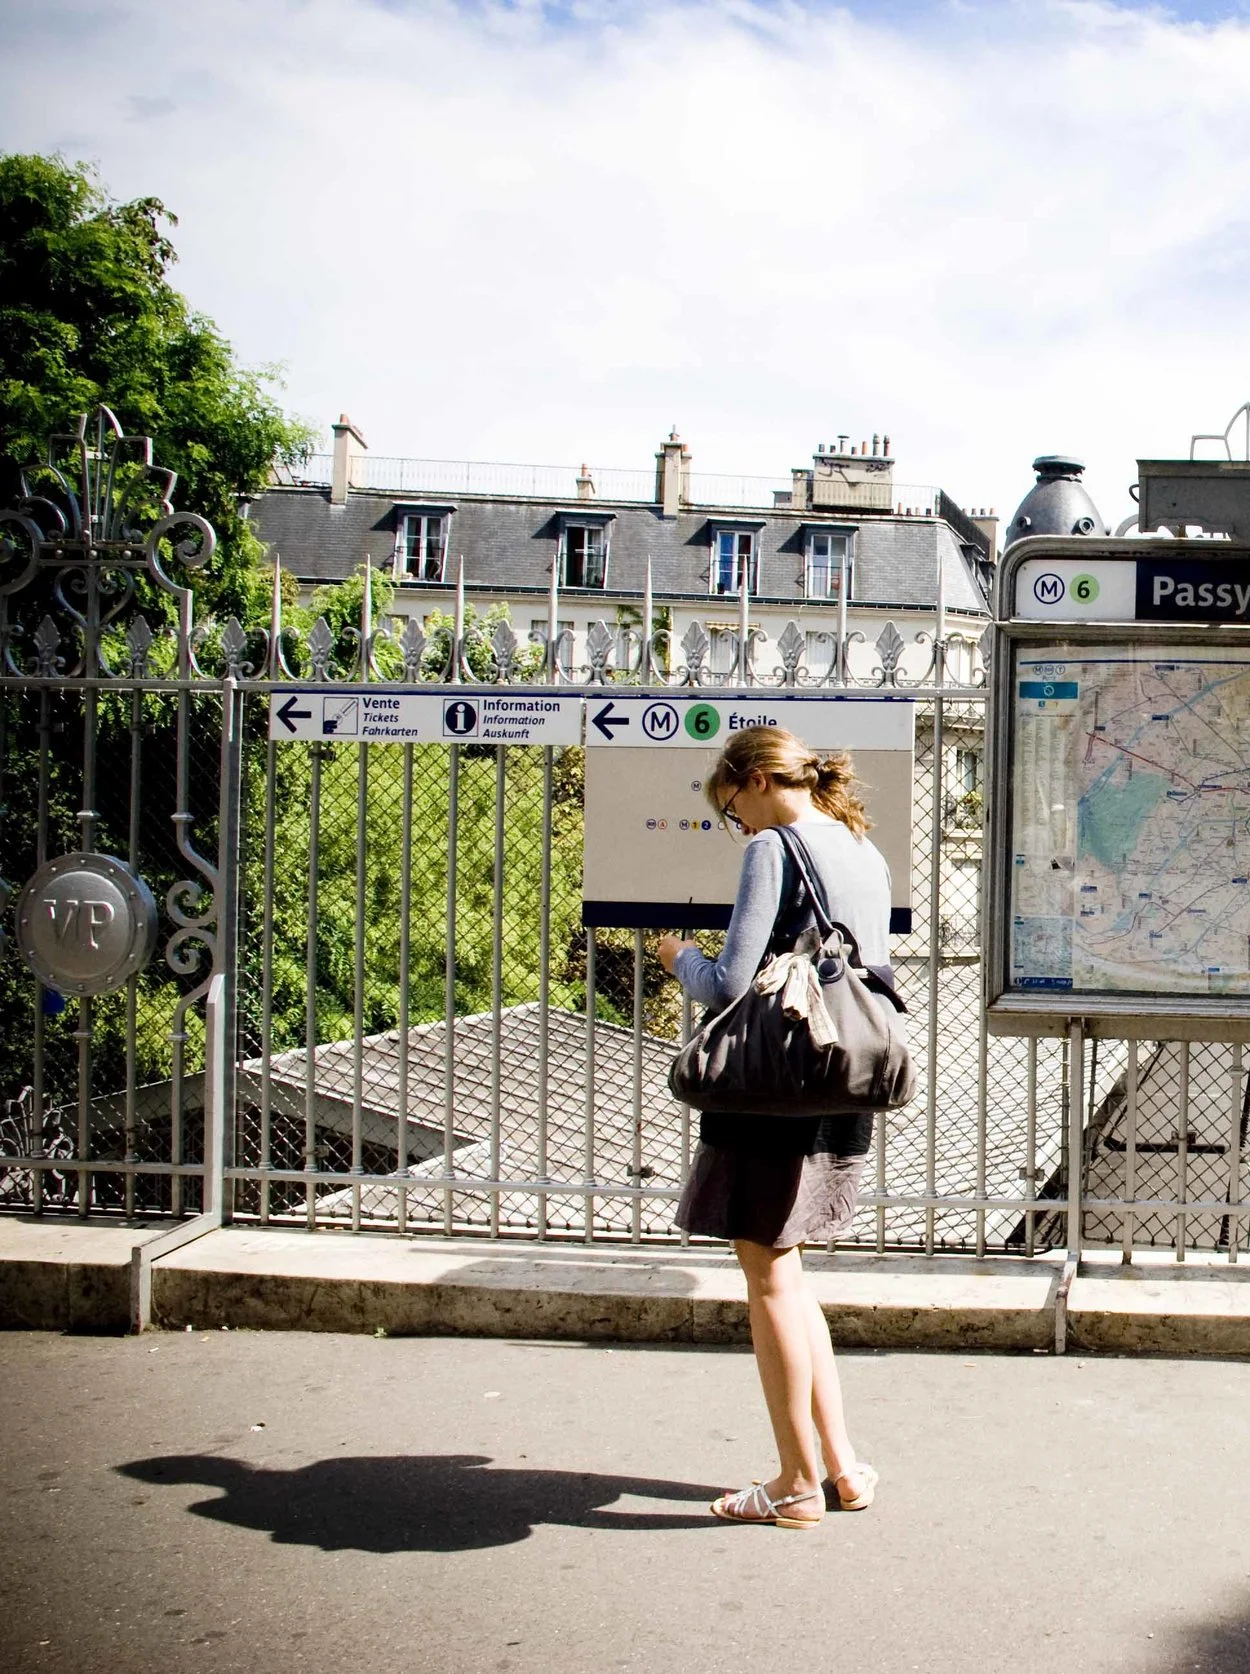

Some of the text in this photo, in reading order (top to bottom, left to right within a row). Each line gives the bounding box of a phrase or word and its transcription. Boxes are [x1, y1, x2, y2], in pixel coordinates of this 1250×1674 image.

[1041, 580, 1058, 597] M
[1077, 580, 1090, 599] 6
[362, 697, 400, 709] Vente
[483, 699, 560, 712] Information
[363, 712, 399, 723] Tickets
[483, 714, 545, 725] Information
[650, 711, 671, 732] M
[694, 711, 710, 734] 6
[362, 726, 418, 736] Fahrkarten
[482, 728, 530, 738] Auskunft
[43, 899, 115, 950] VP
